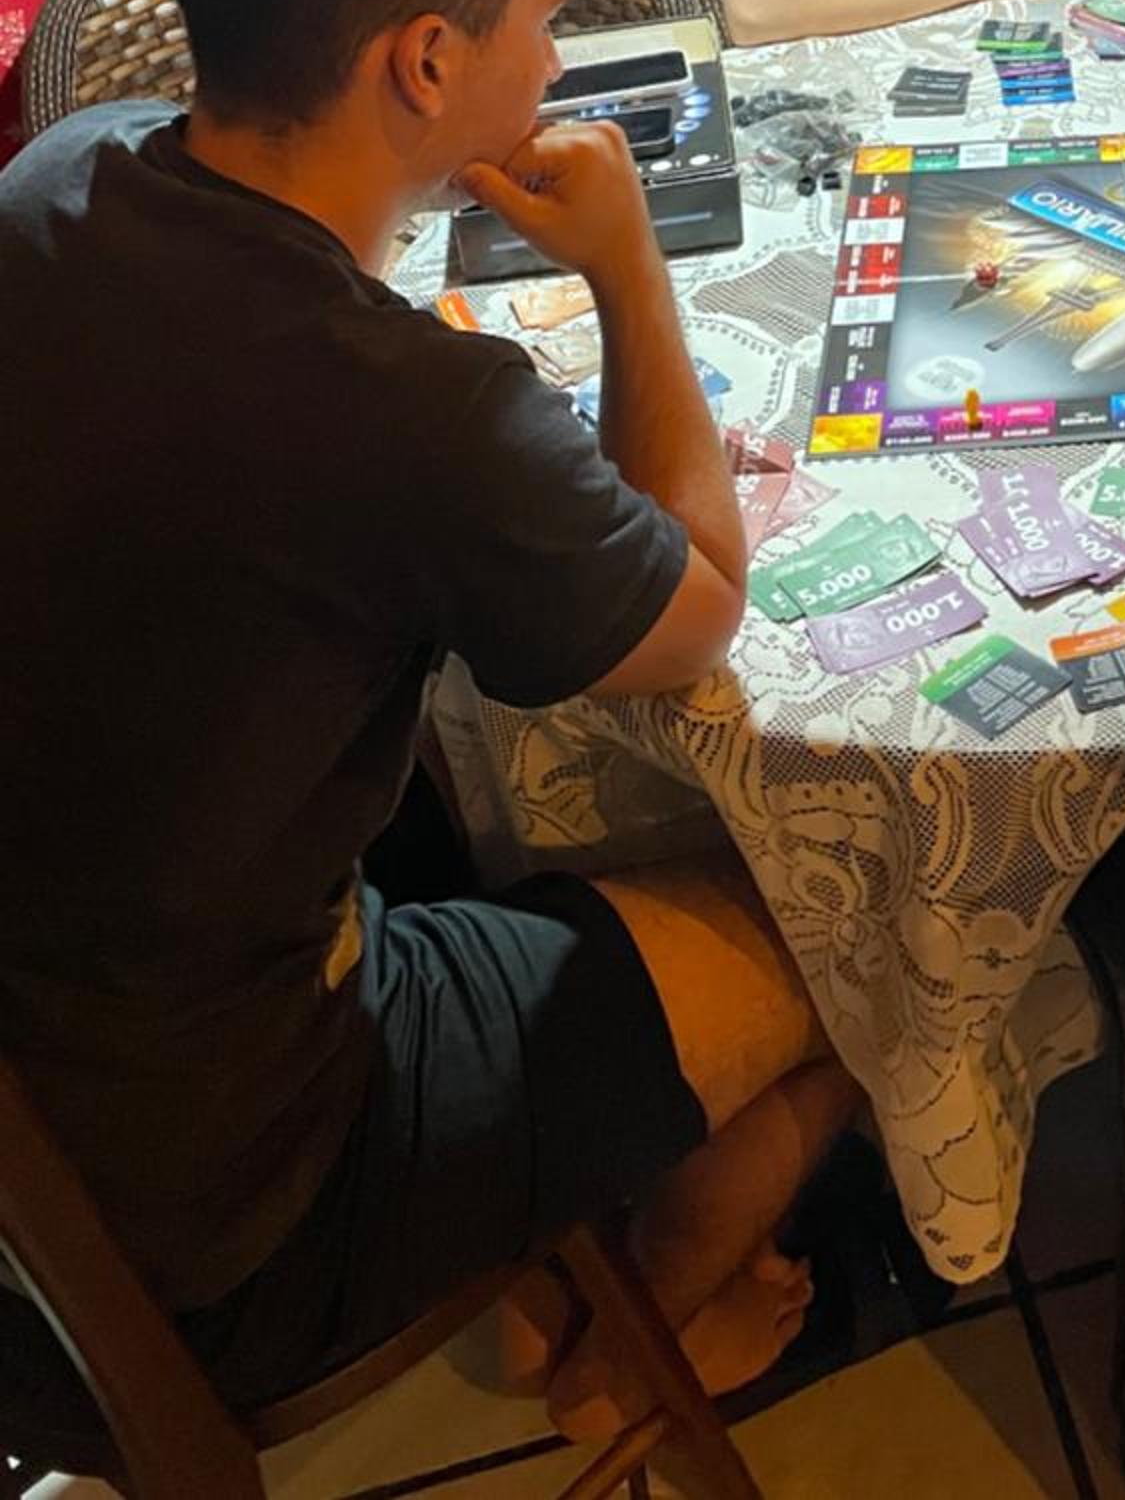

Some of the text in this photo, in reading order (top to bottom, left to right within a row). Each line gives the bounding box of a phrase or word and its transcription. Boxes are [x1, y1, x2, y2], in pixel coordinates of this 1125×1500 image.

[1007, 501, 1050, 550] 1.000
[798, 564, 872, 607] 5.000
[886, 591, 963, 633] 1.000
